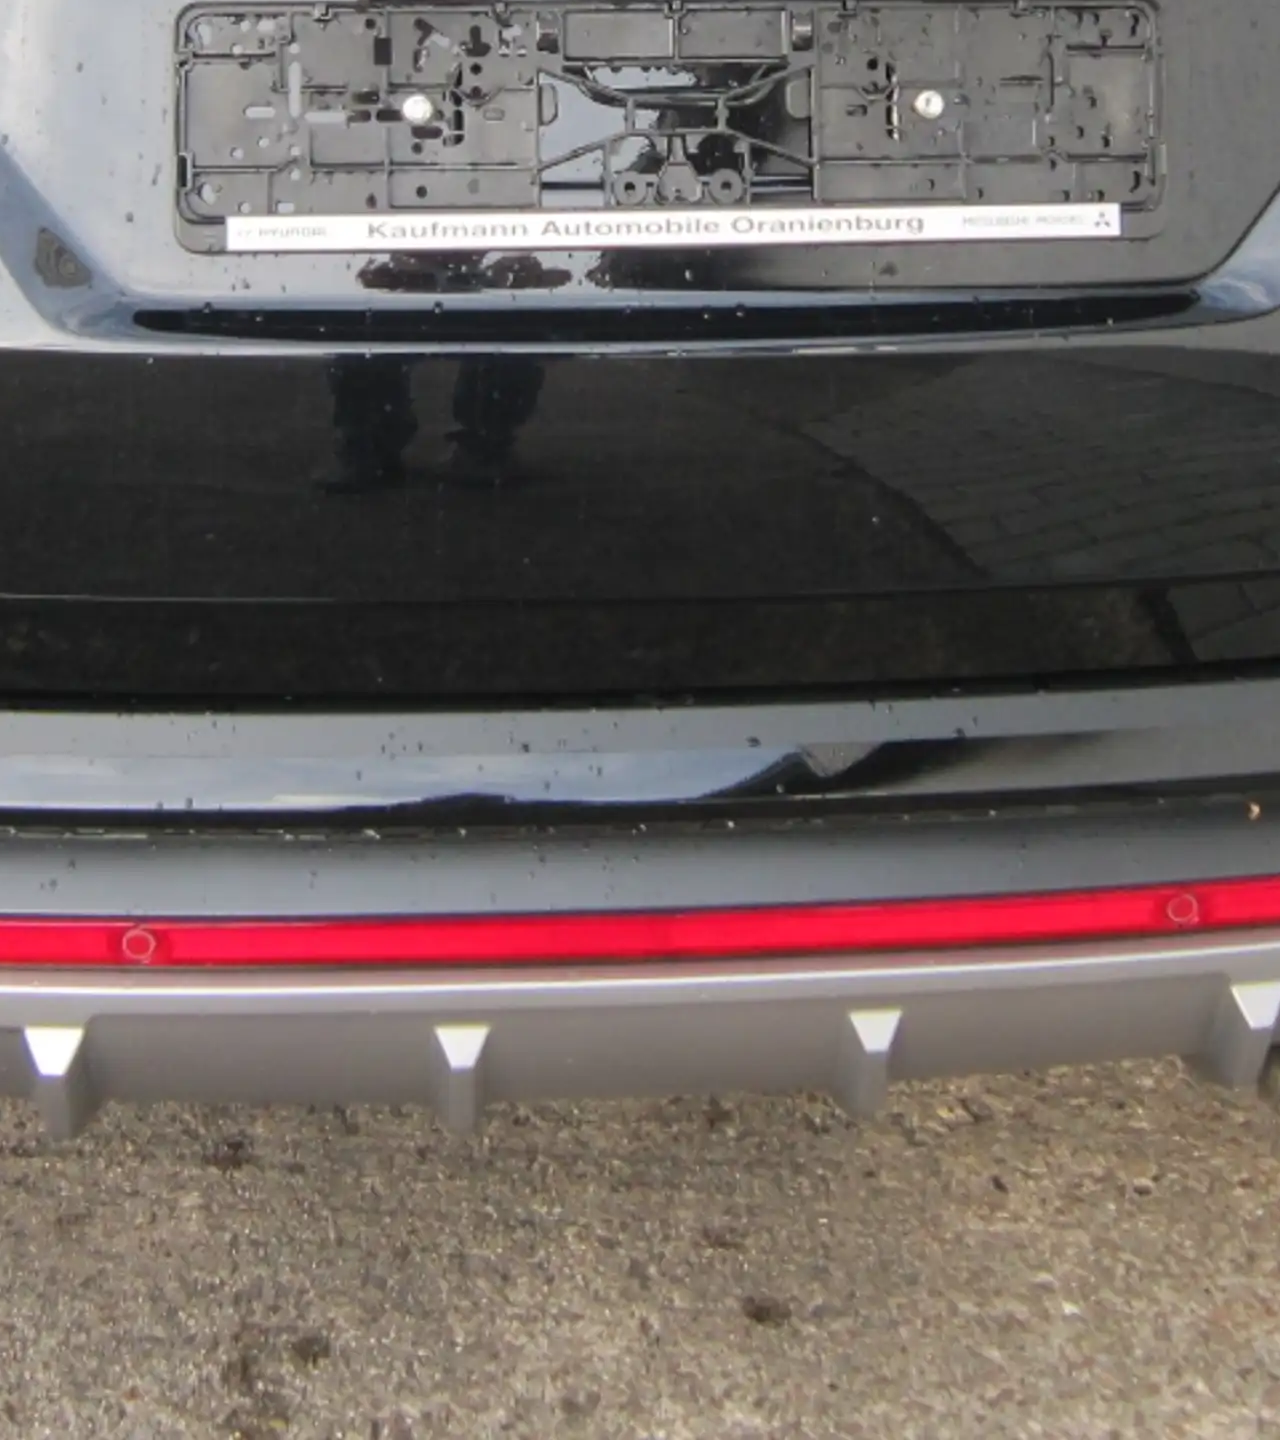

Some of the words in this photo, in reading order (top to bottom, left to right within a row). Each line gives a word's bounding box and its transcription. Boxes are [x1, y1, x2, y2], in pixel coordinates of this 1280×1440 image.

[366, 221, 529, 240] Kaufmann
[540, 216, 720, 237] Automobile
[730, 213, 925, 236] Oranienburg
